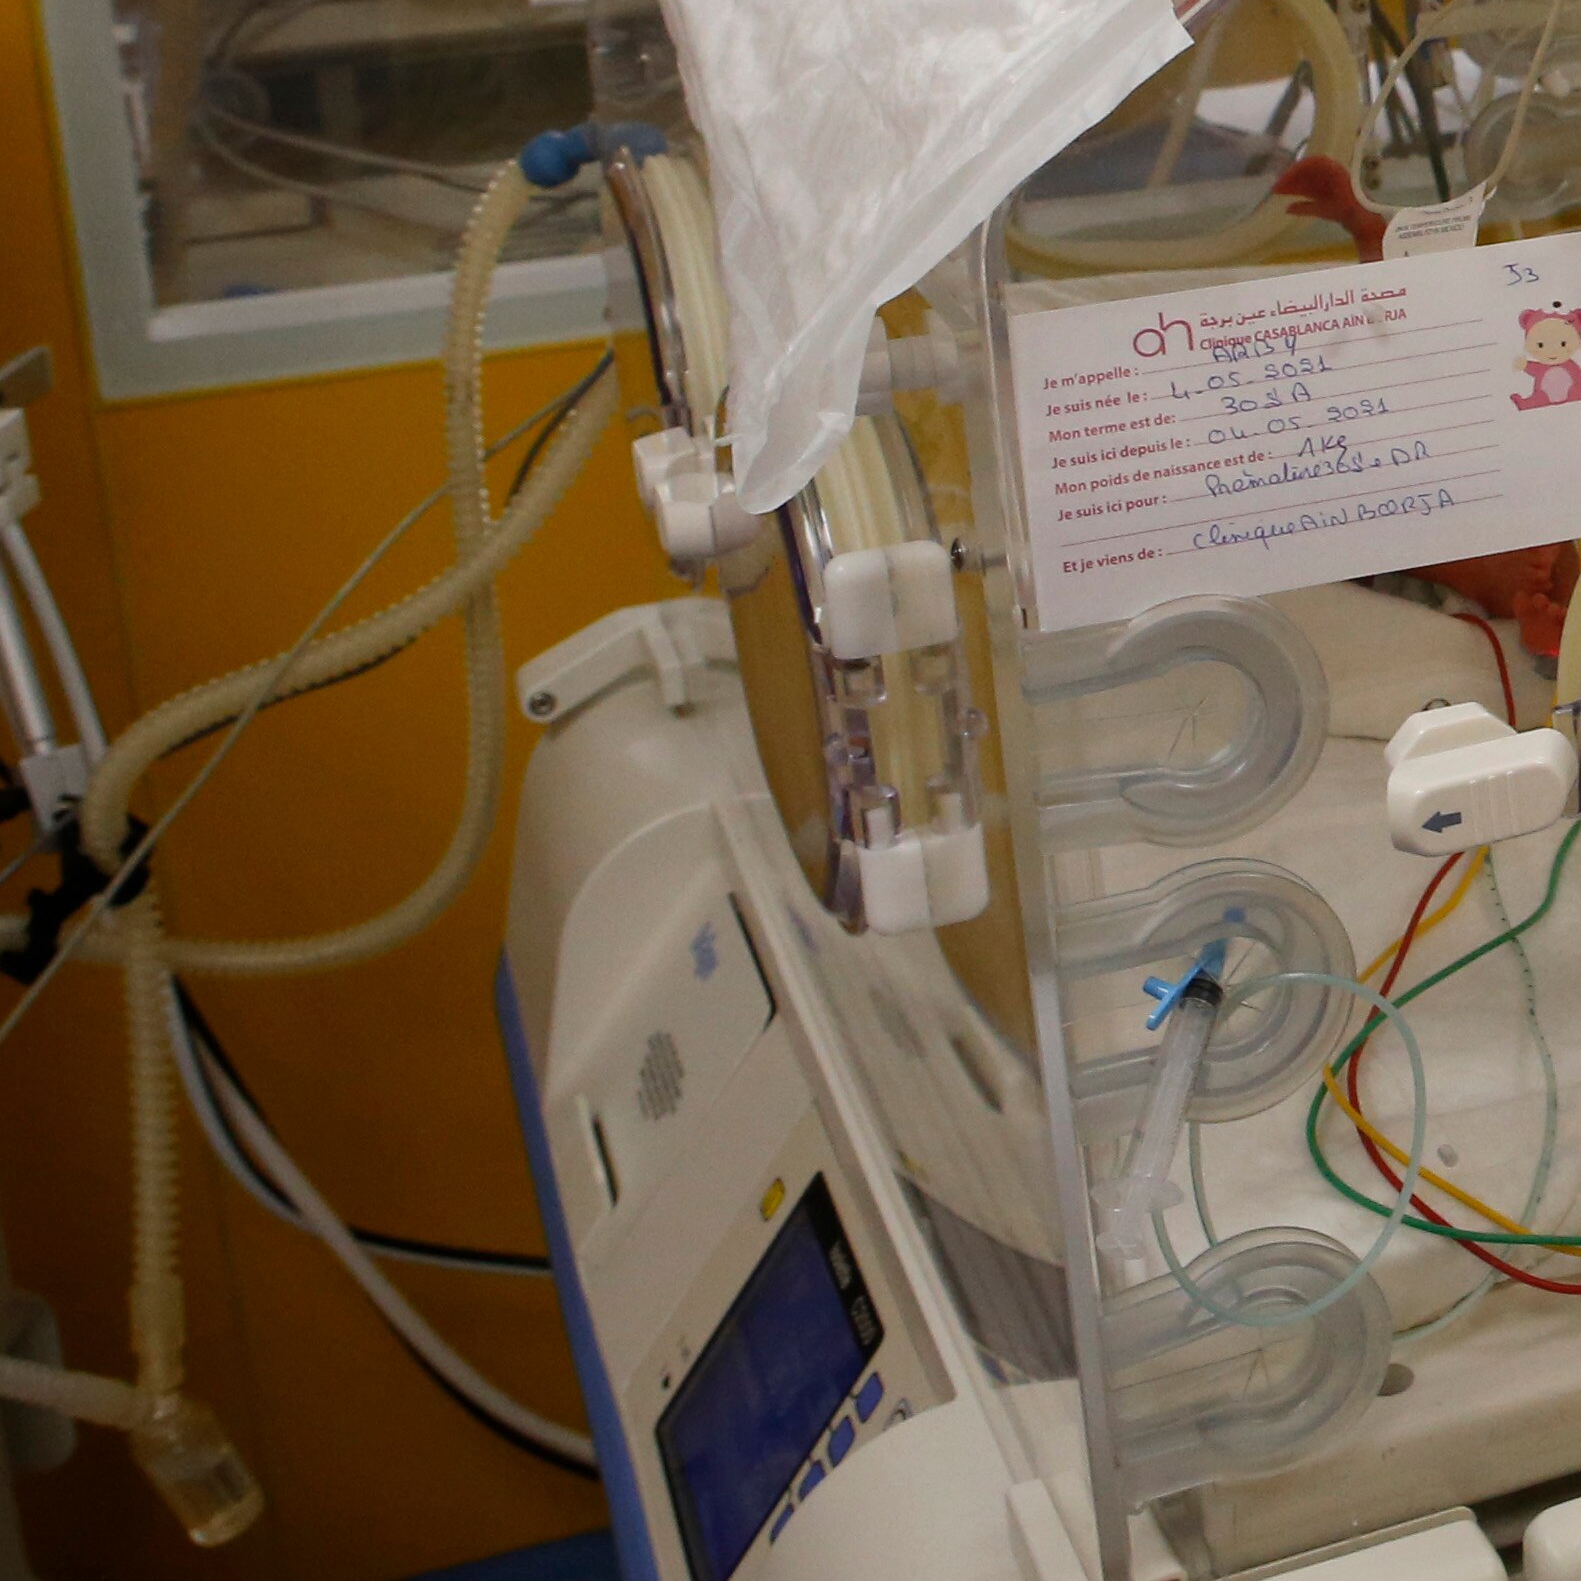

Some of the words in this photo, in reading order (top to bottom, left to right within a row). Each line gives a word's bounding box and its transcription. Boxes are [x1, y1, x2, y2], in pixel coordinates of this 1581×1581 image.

[1200, 333, 1252, 351] Clinique
[1254, 319, 1340, 342] CASABLANCA
[1043, 377, 1058, 390] Je
[1046, 405, 1061, 418] Je
[1064, 400, 1091, 415] suis
[1095, 395, 1121, 411] née
[1048, 429, 1081, 444] Mon
[1084, 422, 1126, 438] terme
[1130, 417, 1151, 431] est
[1051, 457, 1067, 470] Je
[1070, 451, 1098, 466] suis
[1101, 447, 1117, 461] ici
[1120, 441, 1167, 460] depuis
[1170, 437, 1184, 450] le
[1055, 481, 1087, 496] Mon
[1090, 470, 1130, 493] poids
[1133, 466, 1150, 482] de
[1153, 458, 1221, 479] naissance
[1224, 452, 1245, 466] est
[1248, 449, 1265, 463] de
[1057, 510, 1073, 522] Je
[1076, 504, 1104, 518] suis
[1107, 499, 1122, 513] ici
[1126, 495, 1160, 514] pour
[1063, 561, 1077, 573] Et
[1080, 558, 1094, 575] je
[1097, 551, 1134, 567] viens
[1137, 547, 1155, 562] de
